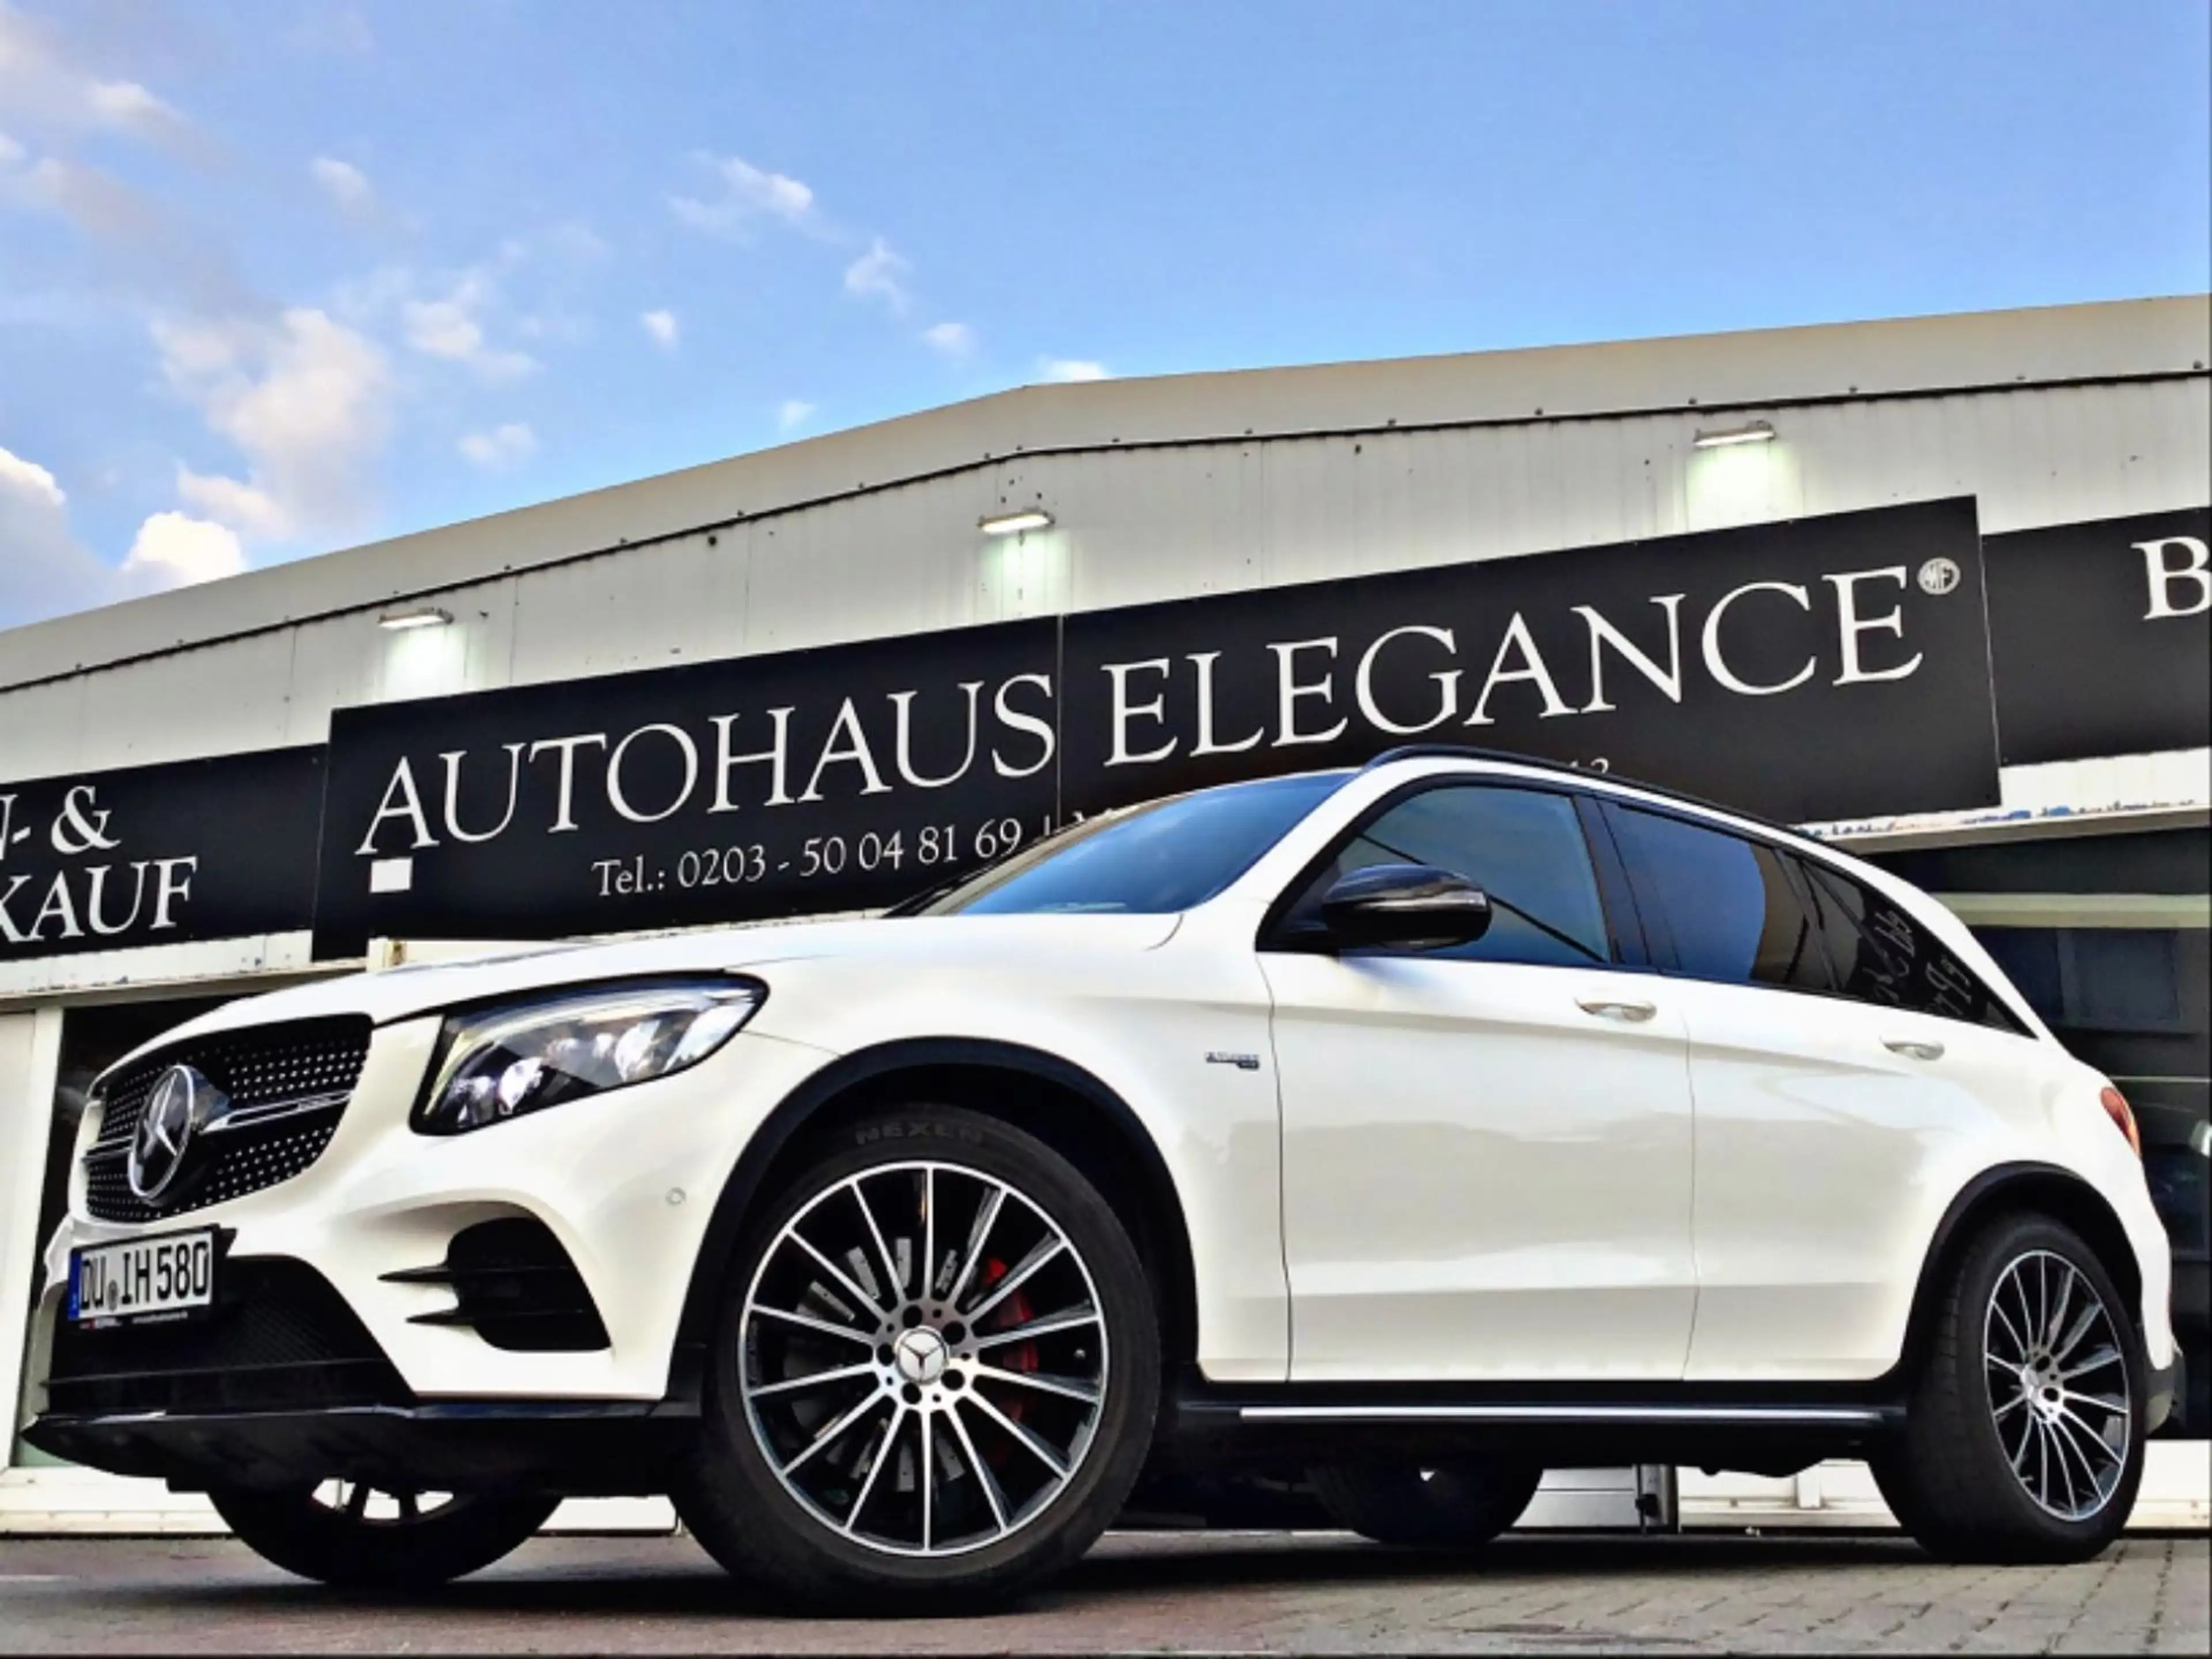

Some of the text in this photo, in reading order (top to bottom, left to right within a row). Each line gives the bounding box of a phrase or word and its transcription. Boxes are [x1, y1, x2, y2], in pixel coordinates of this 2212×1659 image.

[354, 565, 1924, 855] AUTOHAUS ELEGANCE
[51, 785, 122, 854] &
[592, 856, 665, 896] Tel.:
[677, 844, 766, 889] 0203
[799, 837, 847, 877] 50
[858, 830, 904, 870] 04
[918, 824, 959, 864] 81
[974, 817, 1022, 858] 69
[855, 1121, 983, 1146] NEXEN
[121, 1248, 151, 1305] IH
[156, 1240, 210, 1301] 580
